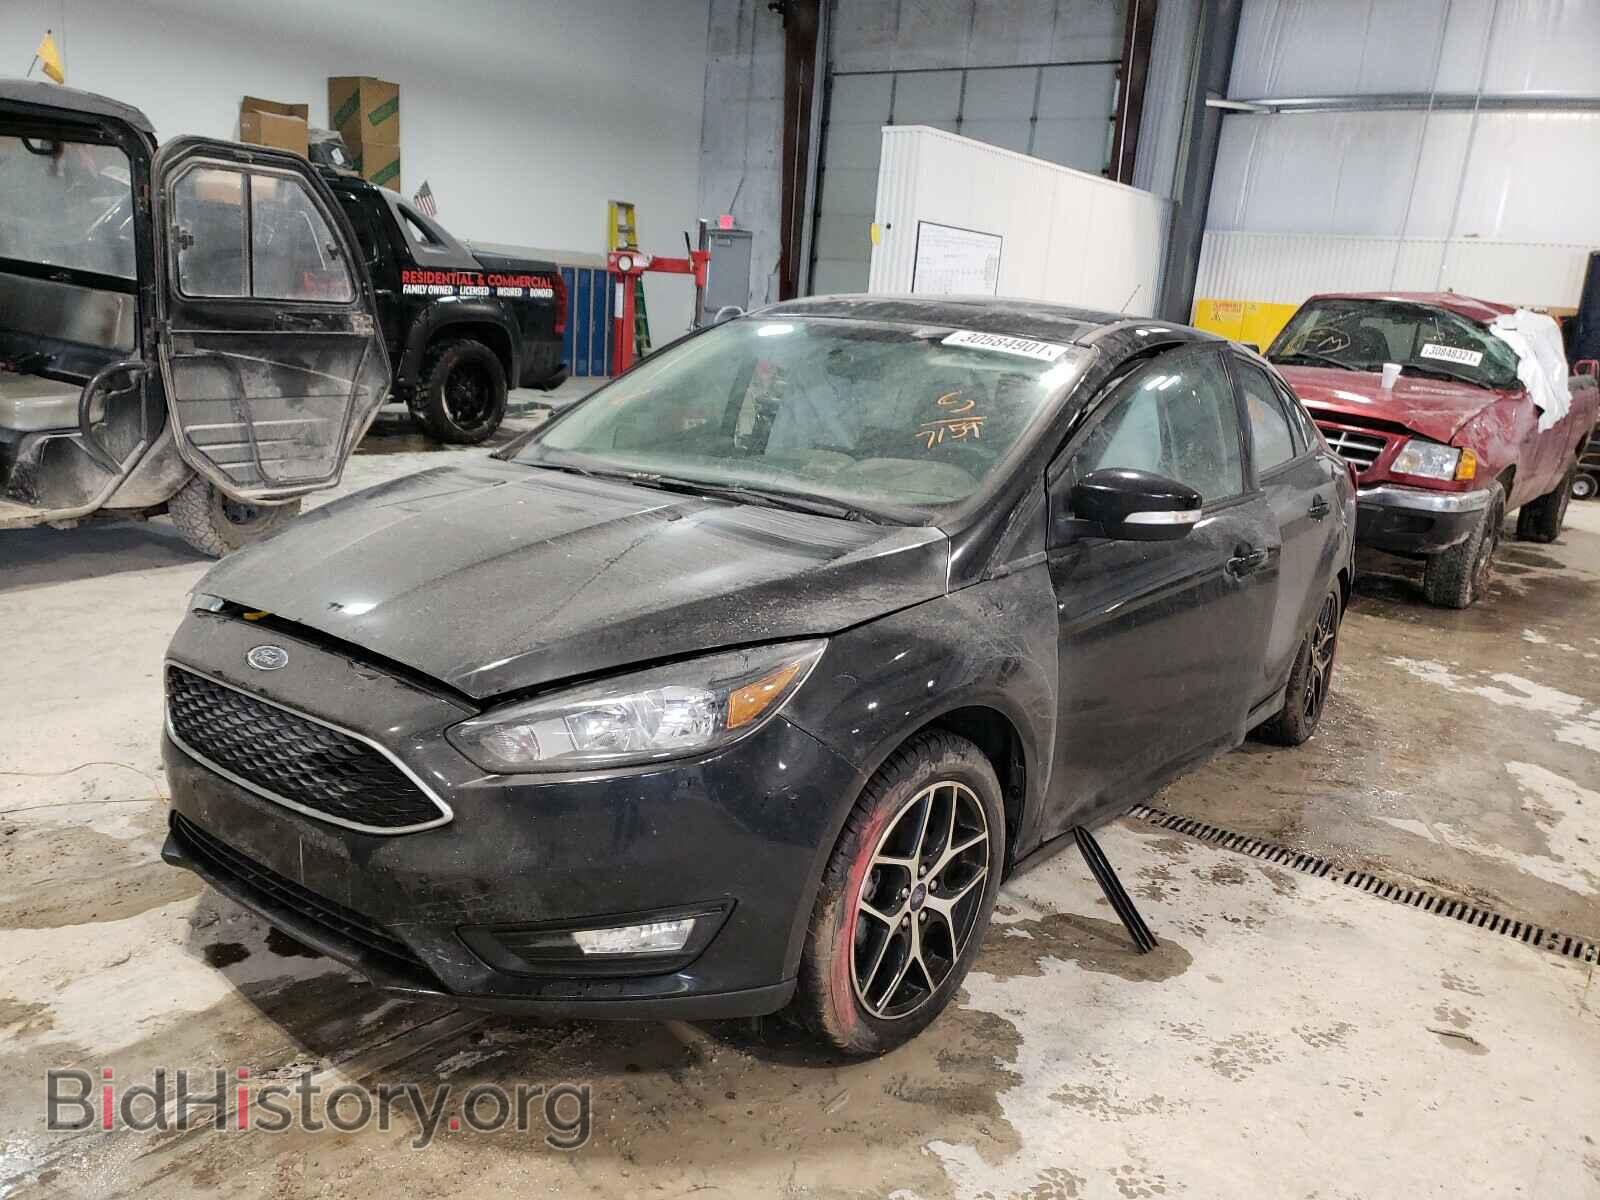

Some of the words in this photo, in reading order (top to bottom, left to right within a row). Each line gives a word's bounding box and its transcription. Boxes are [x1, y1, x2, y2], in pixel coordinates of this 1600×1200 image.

[402, 271, 473, 285] RESIDENTIAL
[477, 272, 484, 285] &
[487, 274, 553, 288] COMMERCIAL
[402, 284, 427, 295] FAMILY
[428, 285, 453, 295] OWNED
[460, 286, 489, 296] LICENSED
[497, 287, 522, 297] INSURED
[530, 288, 553, 298] BONDED
[960, 333, 1049, 354] 30584901
